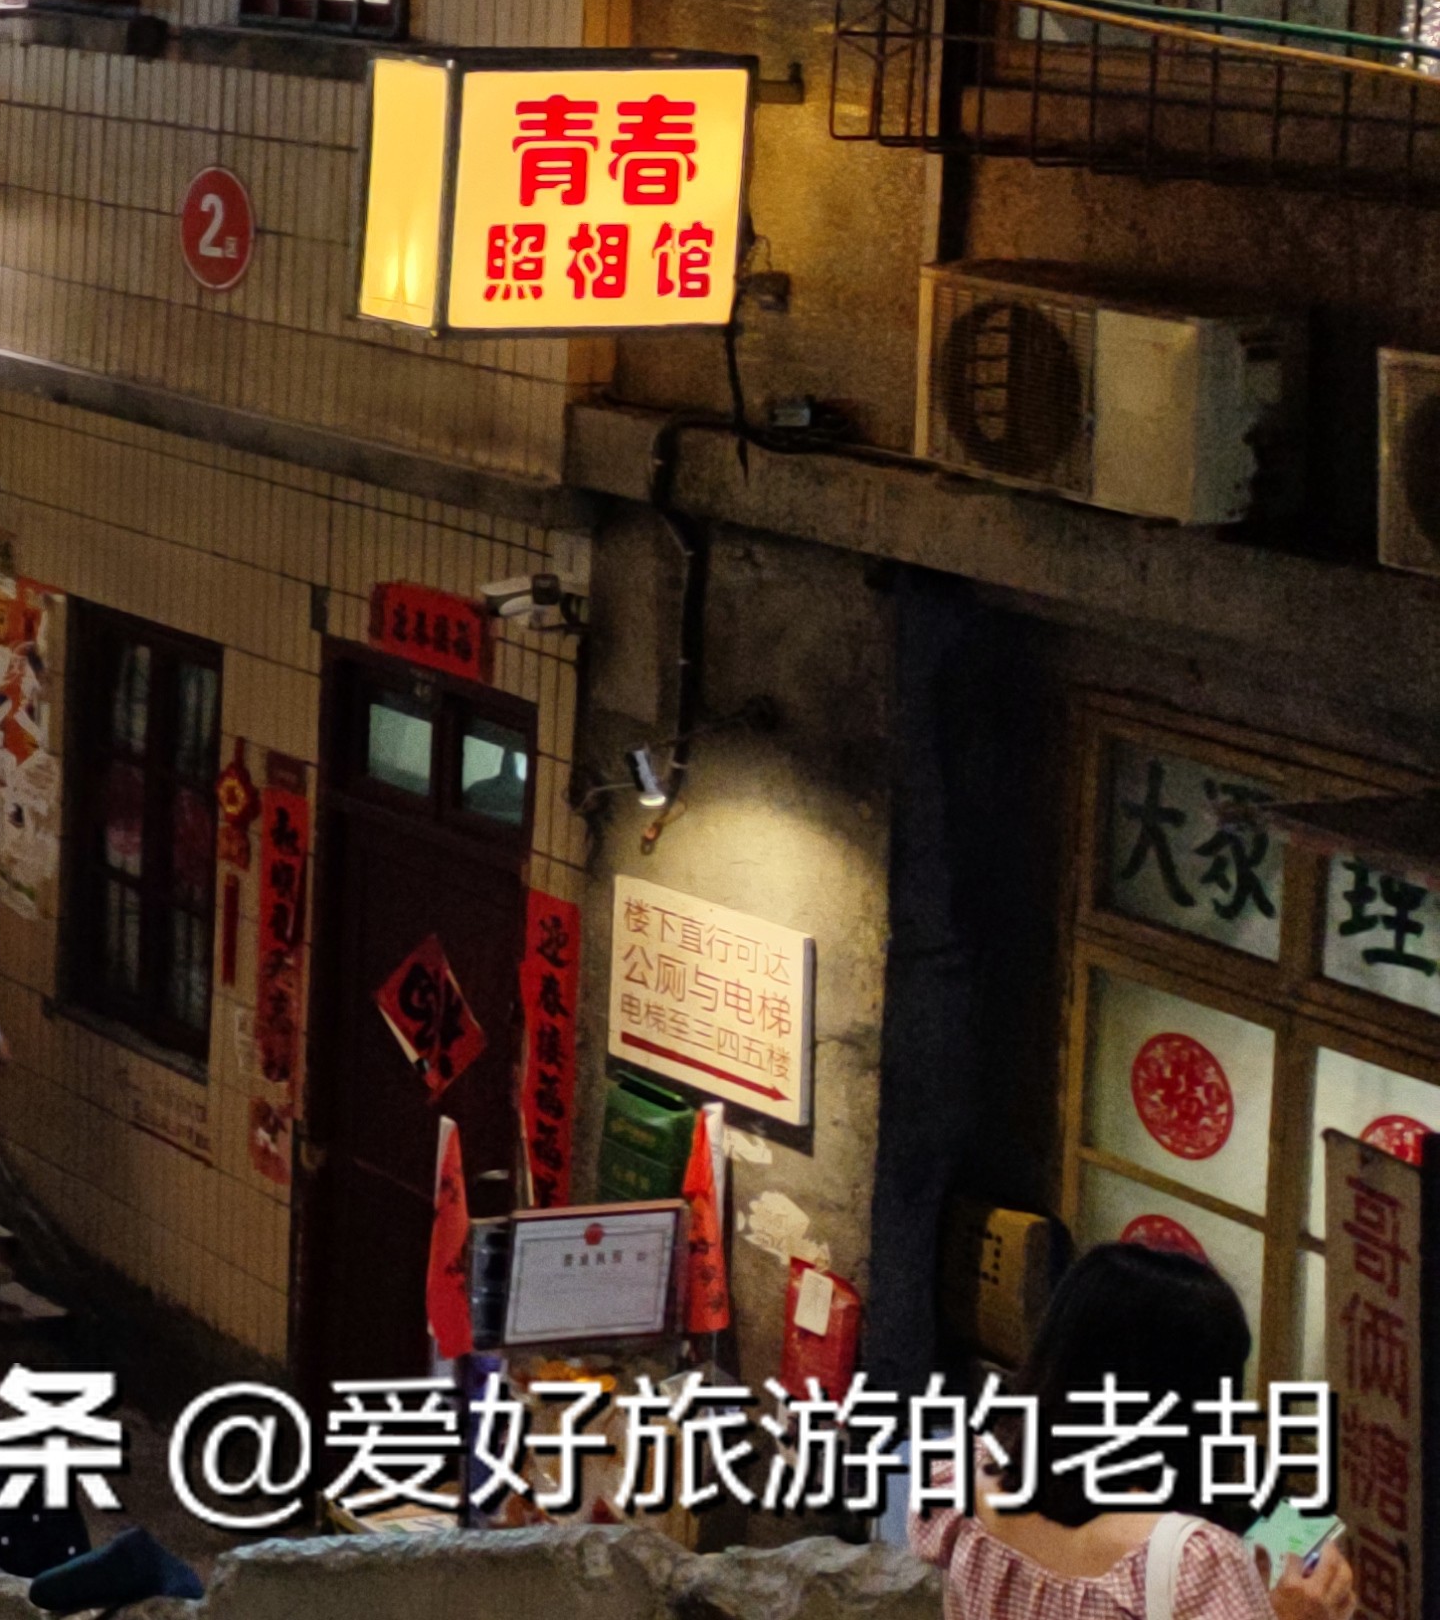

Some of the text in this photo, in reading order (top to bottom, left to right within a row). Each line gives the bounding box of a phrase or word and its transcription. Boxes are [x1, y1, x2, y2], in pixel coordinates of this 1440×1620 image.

[512, 94, 698, 207] 青春
[483, 222, 714, 301] 照相馆
[622, 895, 791, 988] 楼下直行可达
[619, 991, 792, 1082] 电梯至三四五楼
[621, 942, 793, 1039] 公厕与电梯
